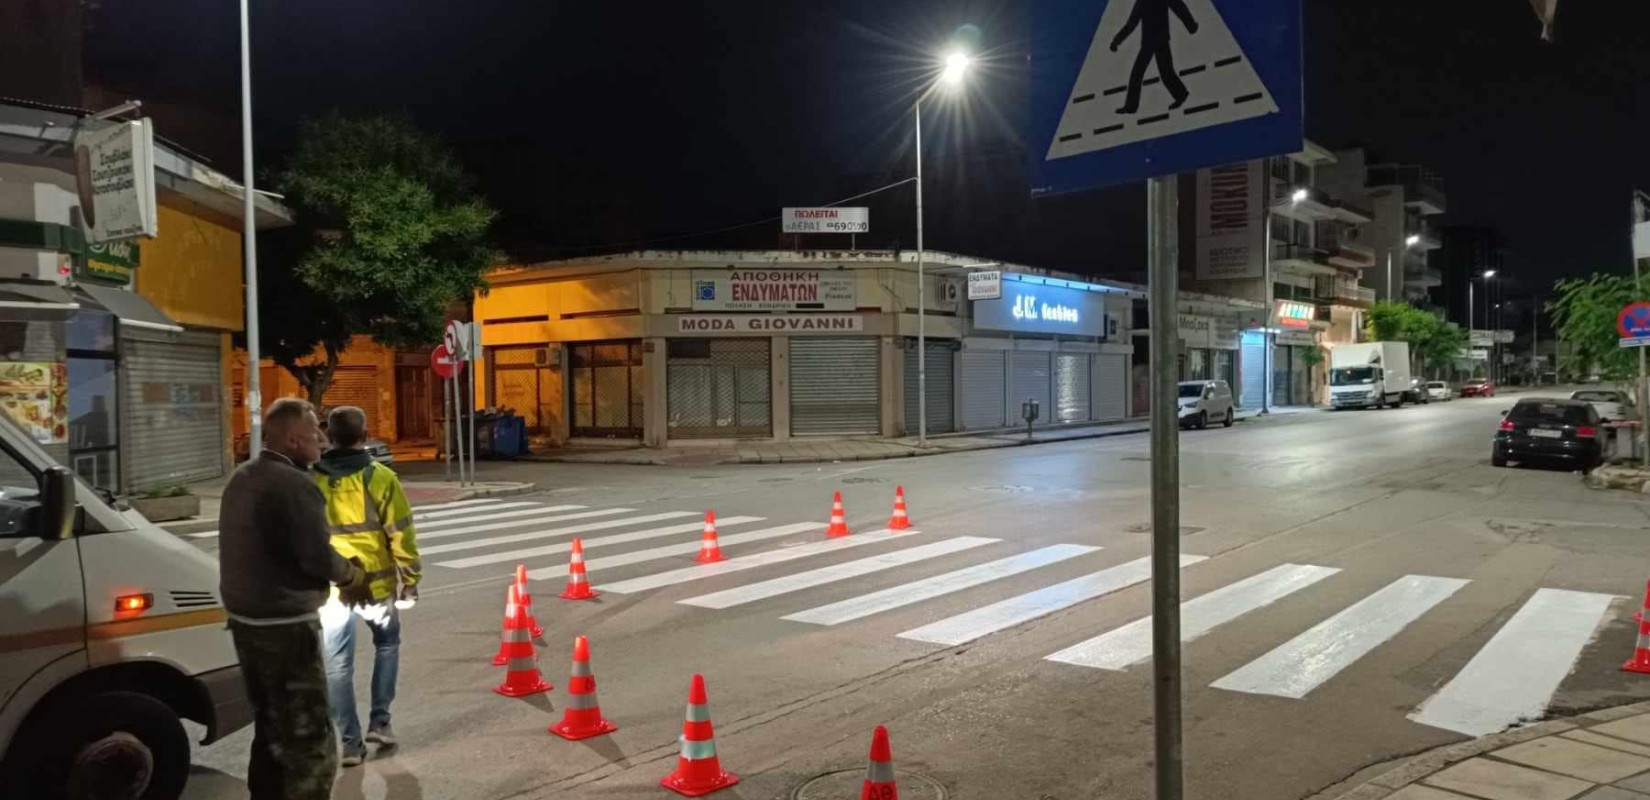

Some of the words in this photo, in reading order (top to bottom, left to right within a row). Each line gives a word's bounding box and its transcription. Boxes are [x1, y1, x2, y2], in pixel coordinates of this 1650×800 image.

[730, 272, 819, 281] ΑΠΟΘΗΚΗ
[732, 284, 817, 301] ΕΝΔΥΜΑΤΩΝ
[682, 319, 735, 330] MODA
[748, 318, 853, 329] GIOVANNI
